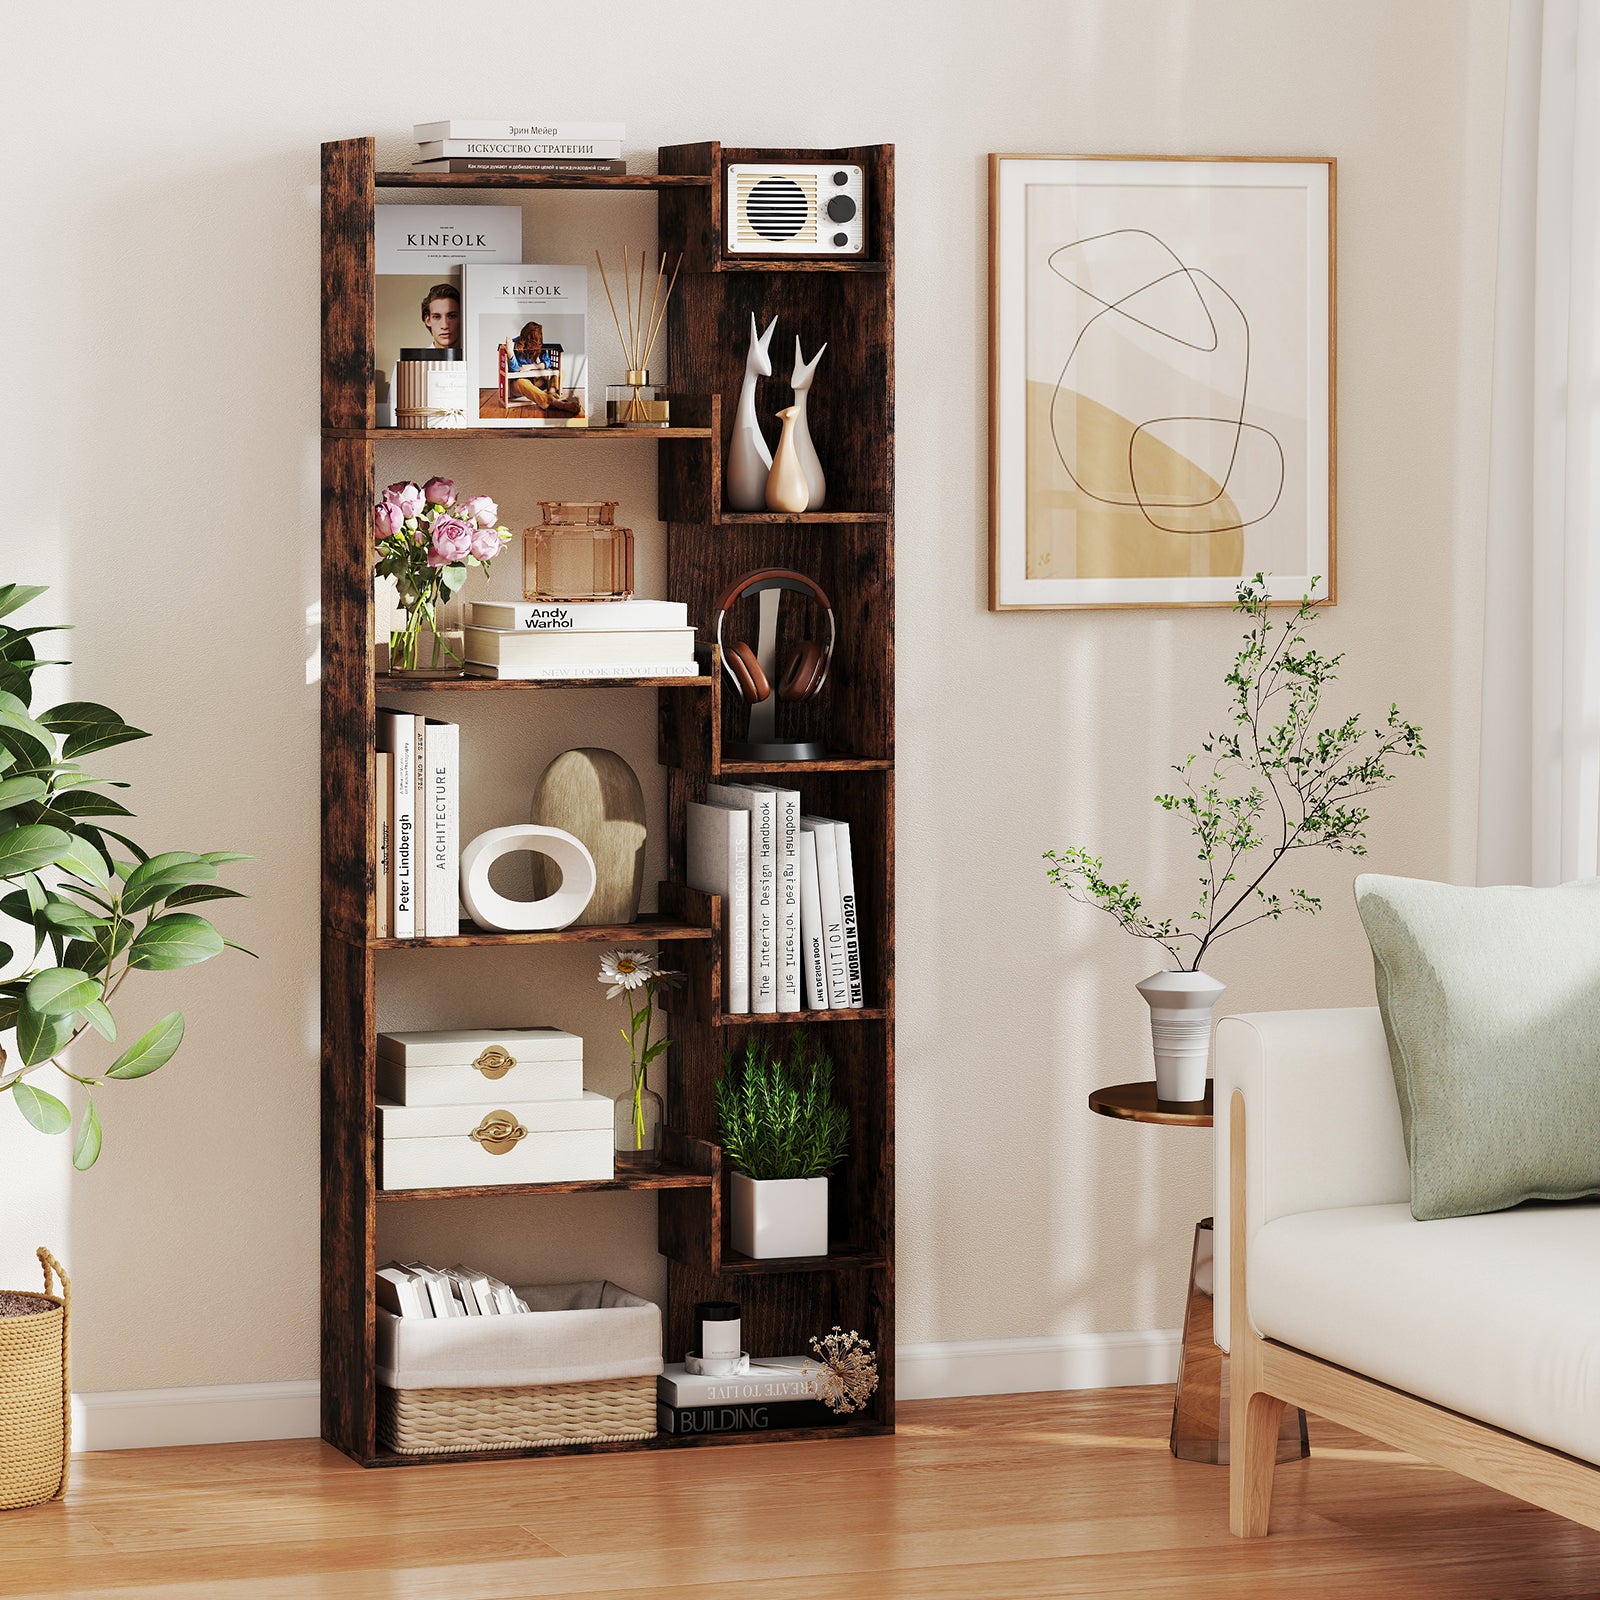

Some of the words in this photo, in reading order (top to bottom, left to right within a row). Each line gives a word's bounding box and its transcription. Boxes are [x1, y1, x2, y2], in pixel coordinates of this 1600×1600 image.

[509, 126, 529, 136] Эрин
[531, 126, 558, 136] Мейер
[467, 144, 531, 153] ИСКУССТВО
[534, 144, 593, 154] СТРАТЕГИИ
[407, 234, 486, 246] KINFOLK
[502, 286, 561, 295] KINFOLK
[525, 618, 574, 629] Warhol
[531, 608, 568, 620] Andy
[542, 669, 571, 677] NEW
[574, 668, 607, 676] LOOK
[612, 666, 695, 676] REVOLUTION
[436, 767, 446, 870] ARCHITECTURE
[760, 802, 770, 857] Handbook
[399, 814, 412, 876] Lindbergh
[736, 838, 746, 906] DECORATES
[399, 880, 409, 912] Peter
[760, 864, 772, 906] Design
[843, 894, 855, 924] 2020
[760, 913, 770, 968] Interior
[846, 926, 857, 937] IN
[736, 914, 746, 983] HOUSEHOLD
[829, 923, 846, 1003] INTUITION
[847, 940, 860, 981] WORLD
[760, 975, 770, 996] The
[851, 982, 862, 1004] THE
[707, 1385, 739, 1399] LIVE
[743, 1384, 761, 1398] TO
[765, 1381, 818, 1396] CREATE
[680, 1407, 769, 1433] BUILDING
